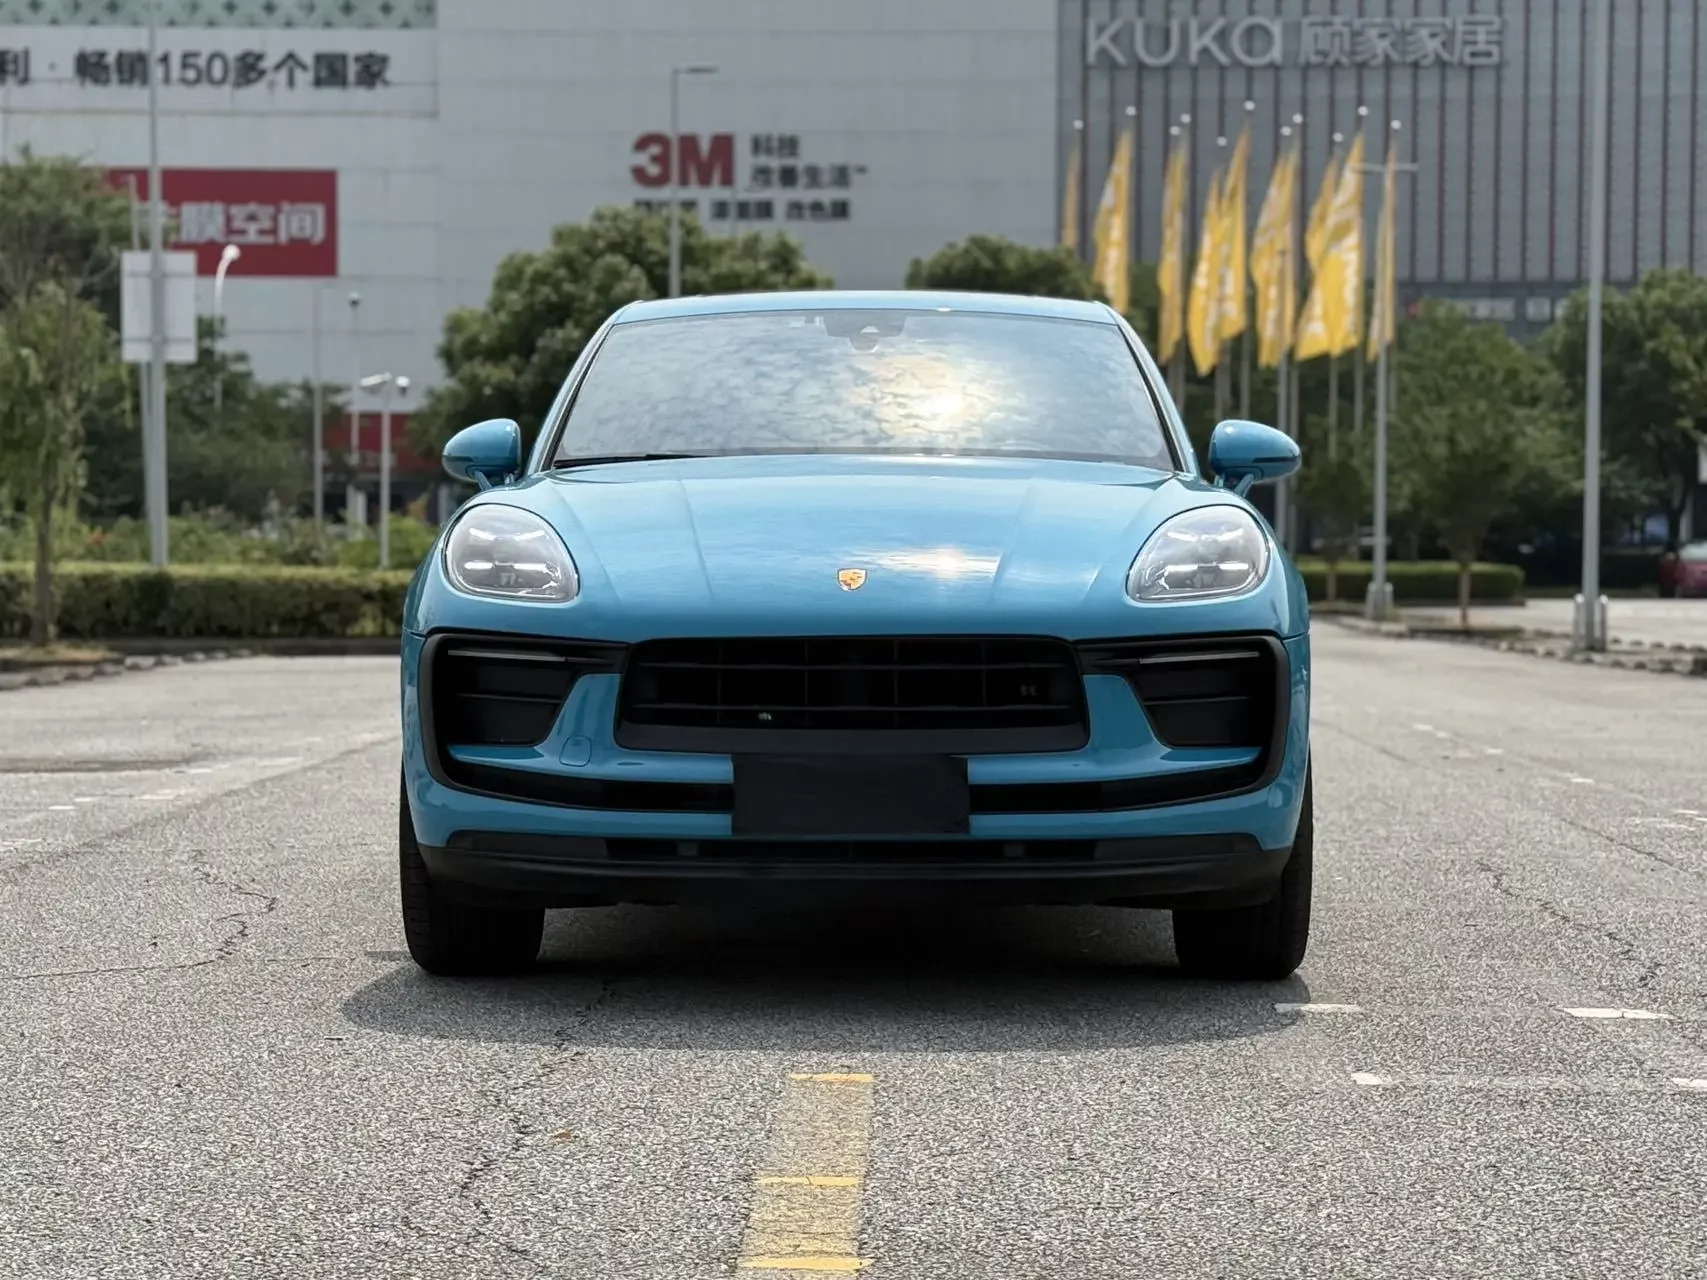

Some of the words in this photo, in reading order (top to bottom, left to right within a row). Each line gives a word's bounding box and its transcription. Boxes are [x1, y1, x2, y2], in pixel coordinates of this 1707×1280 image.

[1301, 15, 1503, 67] 顾家家居
[630, 131, 735, 190] 3M
